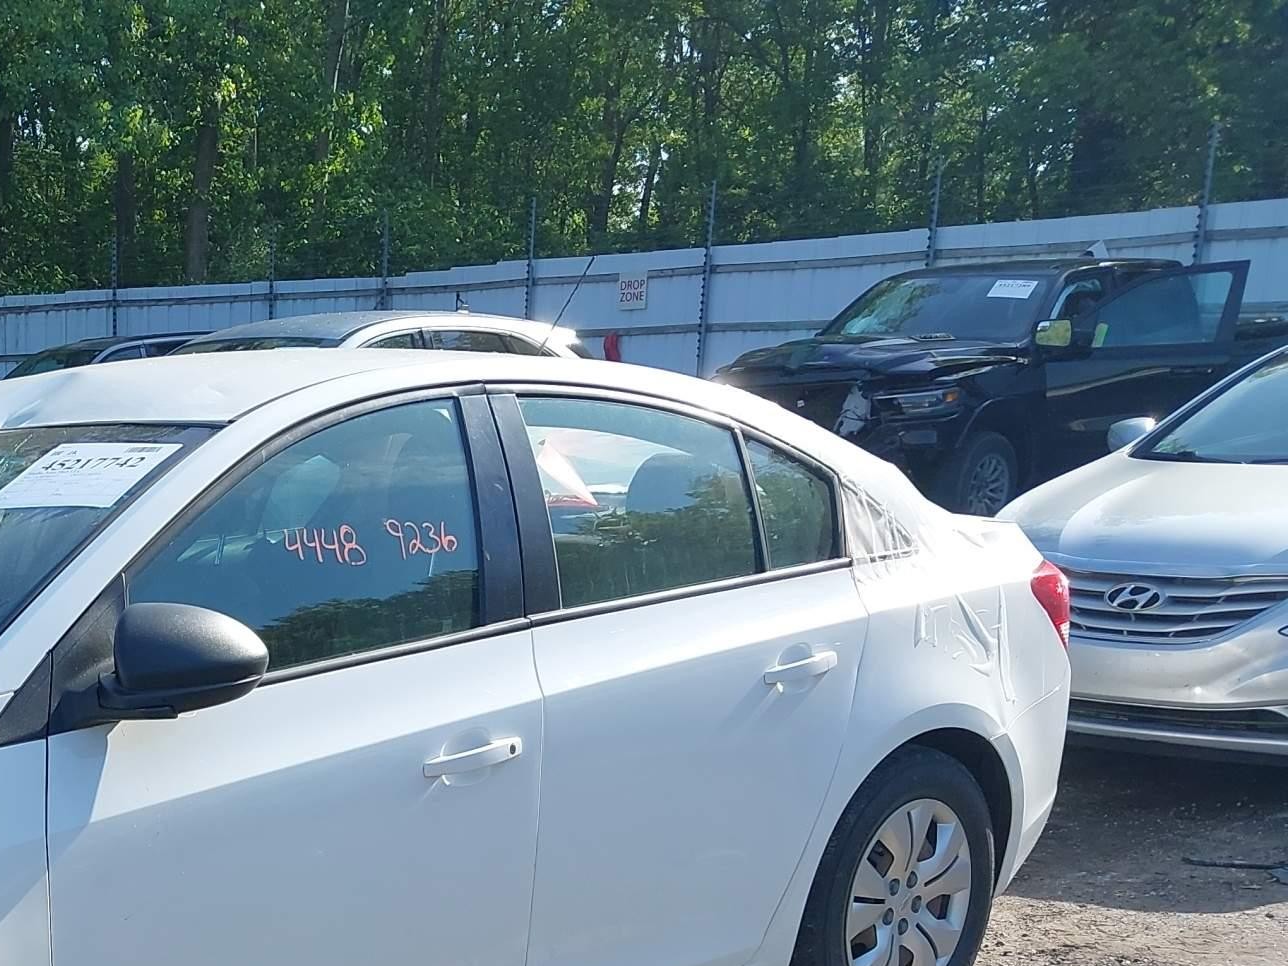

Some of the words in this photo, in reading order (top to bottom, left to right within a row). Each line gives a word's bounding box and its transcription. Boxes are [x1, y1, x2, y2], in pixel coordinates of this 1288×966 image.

[620, 280, 645, 291] DROP
[620, 291, 644, 302] ZONE
[41, 456, 146, 471] 45217742
[385, 518, 458, 561] 9236
